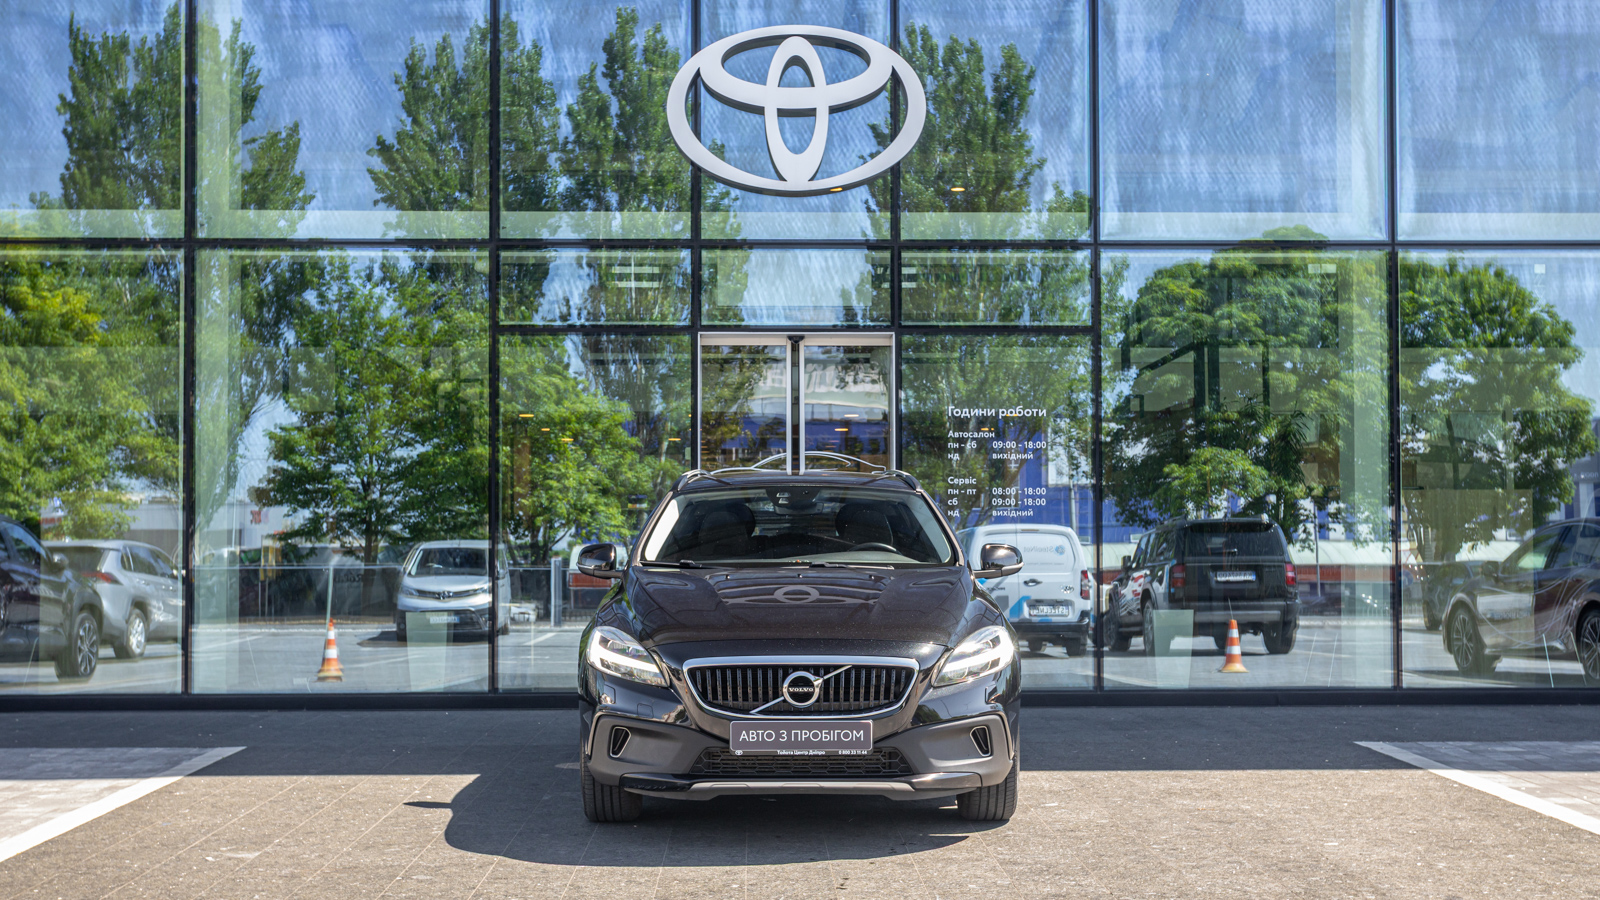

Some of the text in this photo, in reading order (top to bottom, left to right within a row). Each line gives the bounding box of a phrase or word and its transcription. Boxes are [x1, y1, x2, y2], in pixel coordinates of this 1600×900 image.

[948, 406, 1047, 419] Години роботи
[966, 441, 977, 449] сб
[992, 441, 1017, 449] 09:00
[1024, 441, 1047, 449] 18:00
[948, 452, 1034, 461] нд вихідний
[947, 477, 977, 486] Сервіс
[992, 487, 1017, 495] 08:00
[1024, 487, 1047, 495] 18:00
[948, 498, 958, 506] сб
[992, 498, 1016, 506] 09:00
[1024, 498, 1046, 506] 18:00
[948, 509, 1034, 518] нд вихідний
[739, 730, 864, 742] АВТО З ПРОБІГОМ
